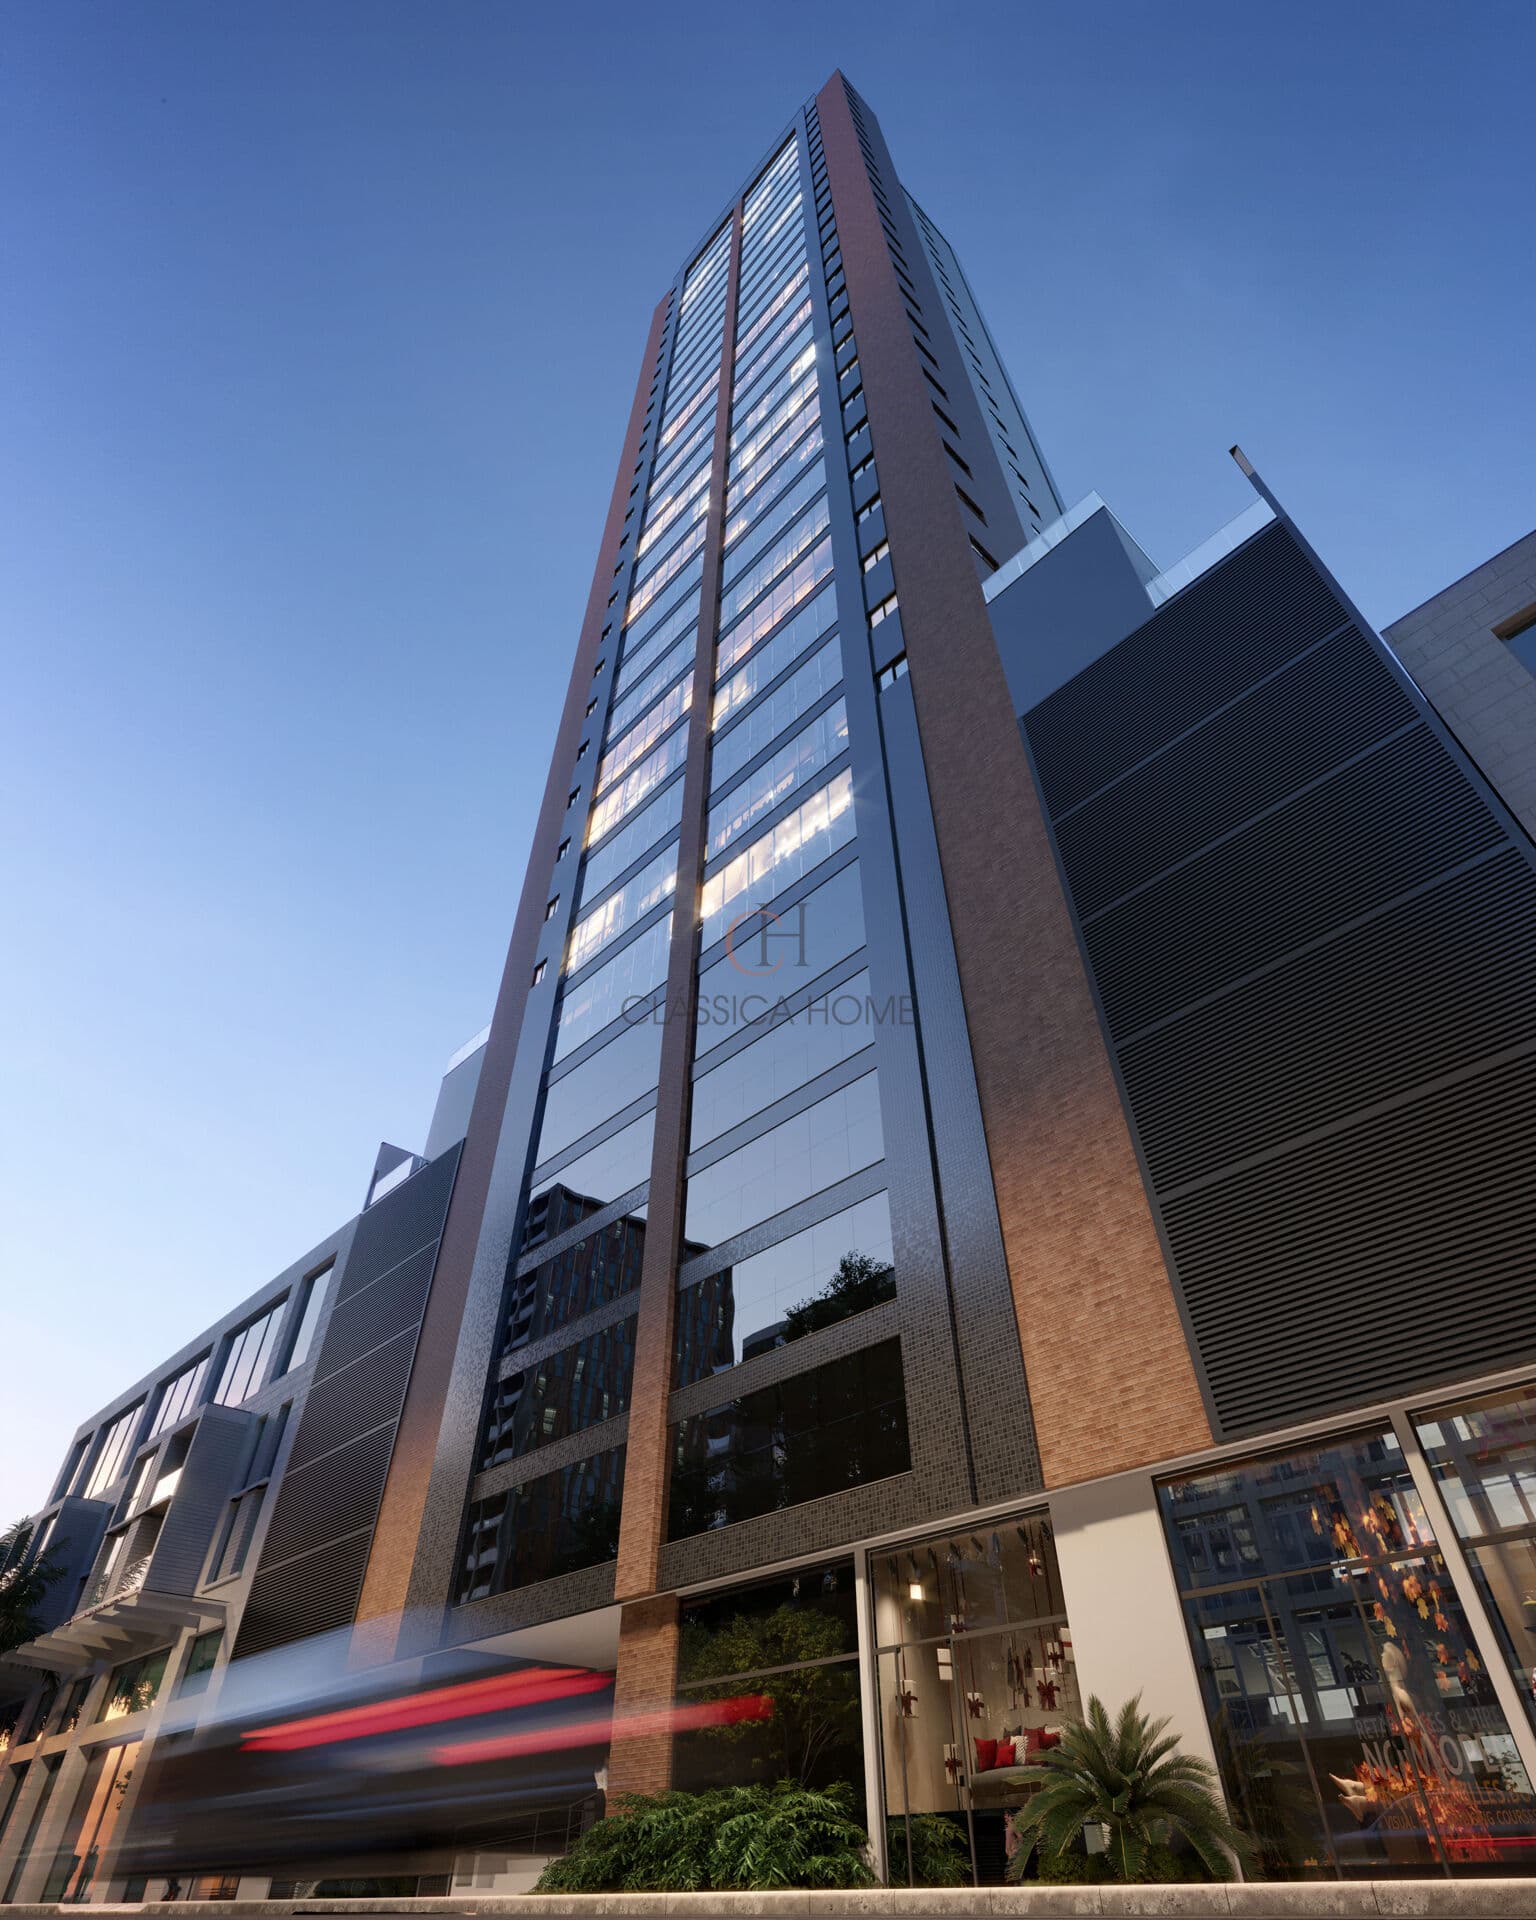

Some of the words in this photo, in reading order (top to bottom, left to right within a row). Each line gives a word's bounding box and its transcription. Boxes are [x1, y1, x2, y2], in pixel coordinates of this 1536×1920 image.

[1355, 1713, 1398, 1740] RETA
[1438, 1729, 1515, 1777] OPE
[1383, 1814, 1416, 1830] VISUAL
